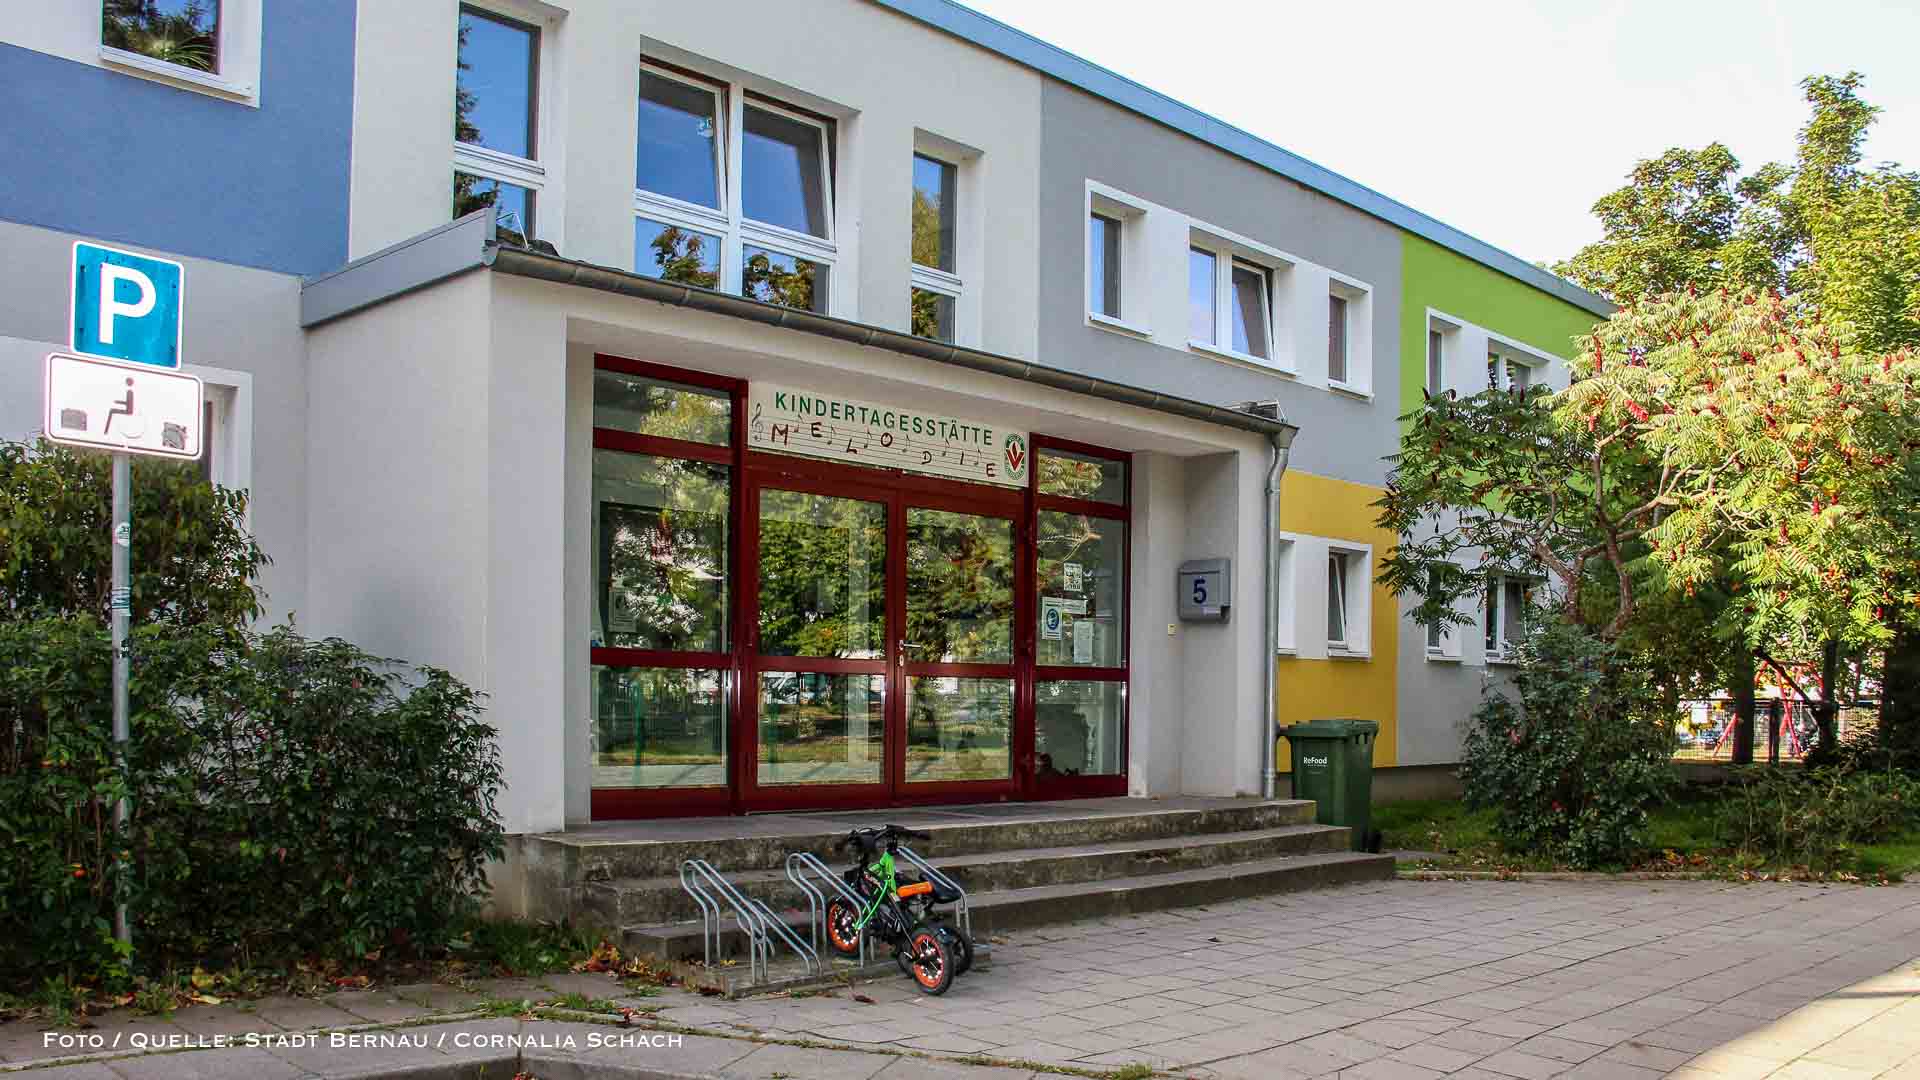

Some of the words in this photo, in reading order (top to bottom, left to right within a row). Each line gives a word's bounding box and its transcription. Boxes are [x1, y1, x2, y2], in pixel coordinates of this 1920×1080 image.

[99, 263, 157, 344] P
[775, 391, 993, 446] KINDERTAGESSTÄTTE
[1193, 579, 1207, 604] 5
[1303, 756, 1328, 765] ReFood
